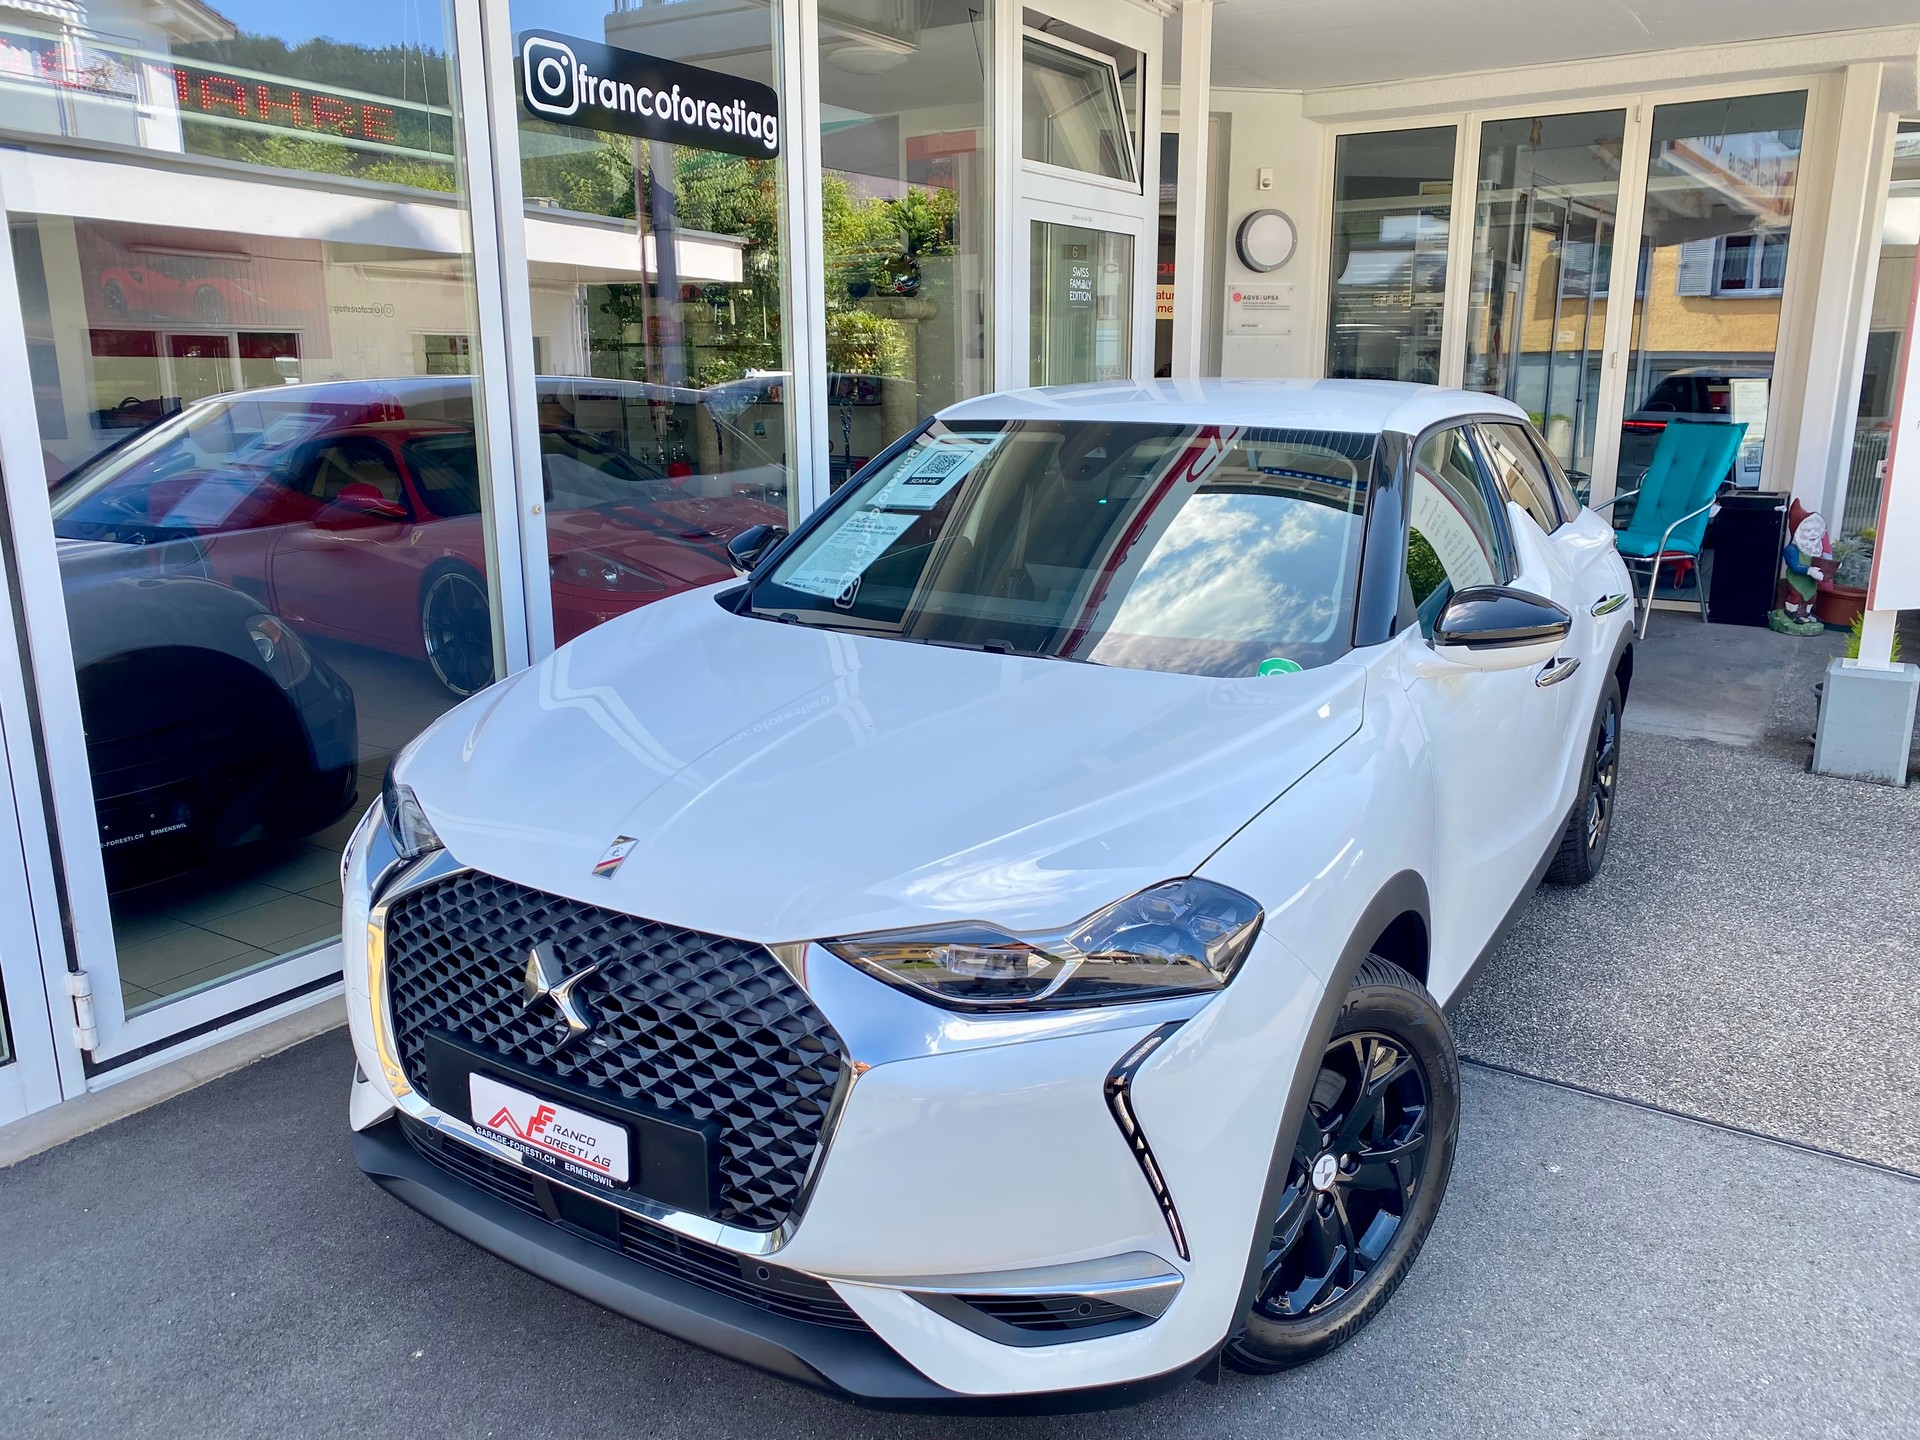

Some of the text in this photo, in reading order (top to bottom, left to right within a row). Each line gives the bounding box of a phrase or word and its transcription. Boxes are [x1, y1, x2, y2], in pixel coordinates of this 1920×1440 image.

[578, 63, 778, 150] francoforestiag
[1072, 246, 1079, 258] 6
[1072, 267, 1090, 278] SWISS
[1069, 290, 1092, 301] EDITION
[150, 822, 188, 836] ERMENSWIL
[476, 1126, 615, 1188] GARAGE-FORESTI.CH ERMENSWIL
[592, 1155, 612, 1167] AG
